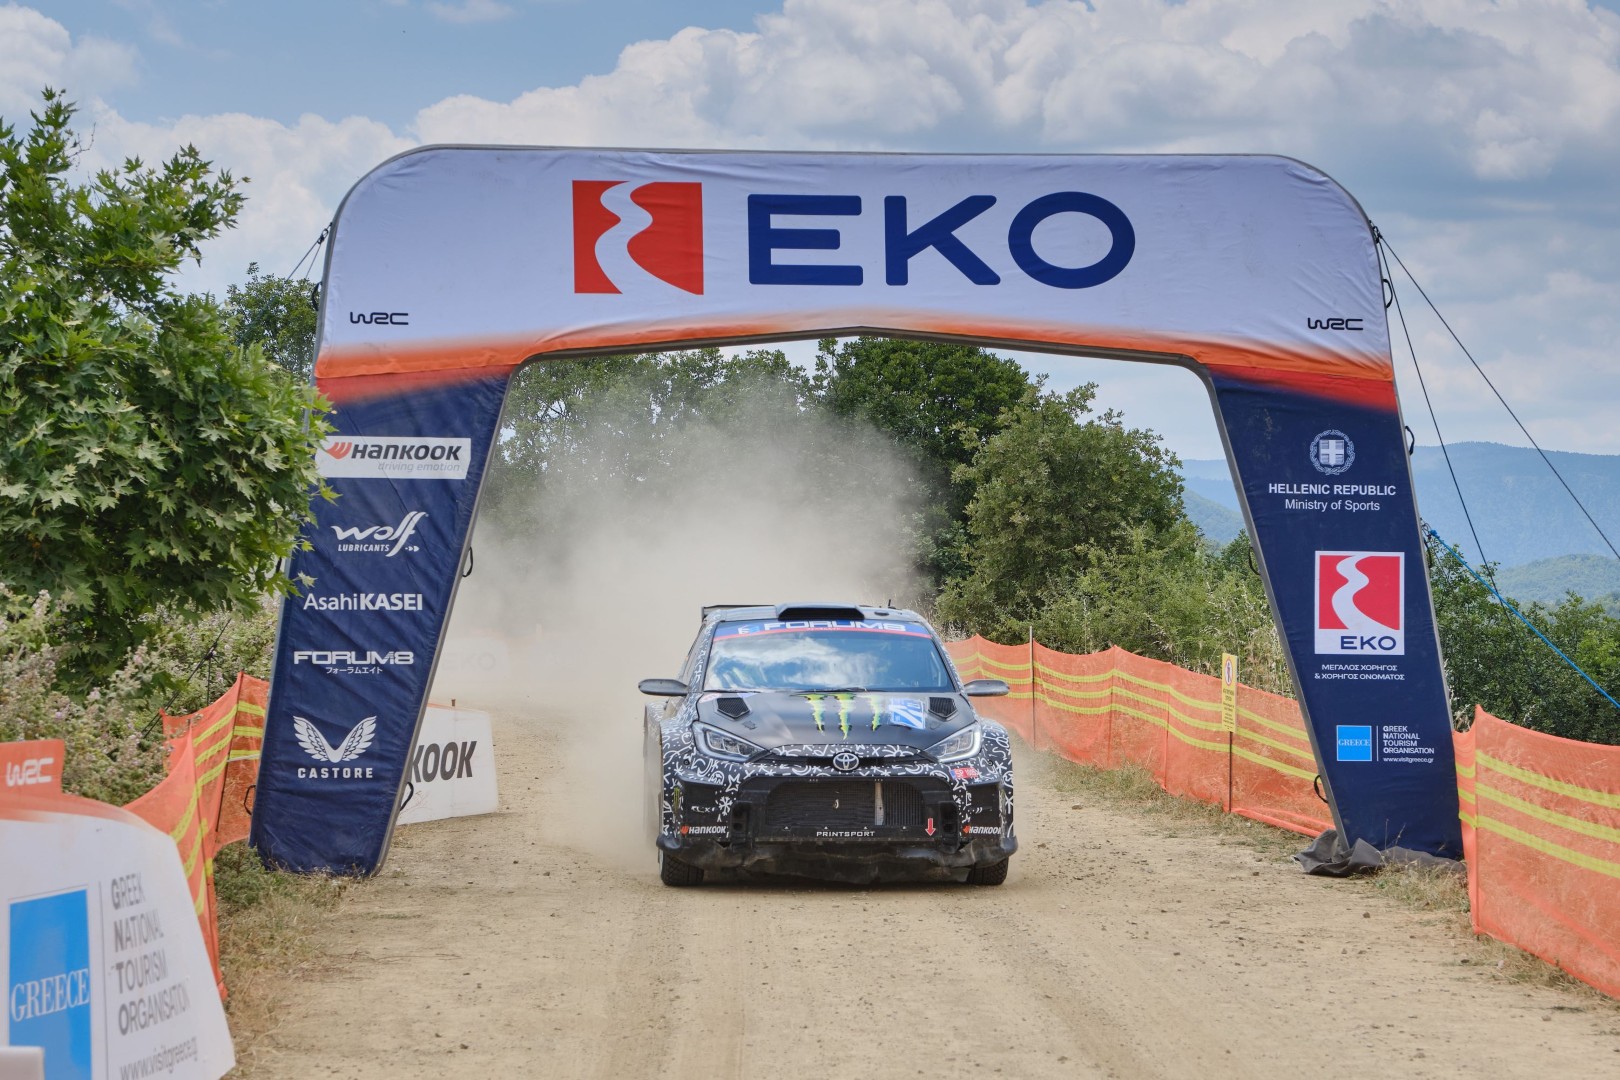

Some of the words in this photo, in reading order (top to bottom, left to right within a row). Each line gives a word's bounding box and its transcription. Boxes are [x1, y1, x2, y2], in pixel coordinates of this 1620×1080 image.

[748, 191, 1135, 289] EKO
[350, 311, 409, 325] WRC
[1307, 317, 1363, 331] WRC
[378, 461, 414, 472] driving
[417, 463, 460, 471] emotion
[1268, 483, 1330, 494] HELLENIC
[1333, 485, 1396, 495] REPUBLIC
[1285, 499, 1328, 512] Ministry
[1331, 500, 1341, 510] of
[1344, 500, 1380, 512] Sports
[338, 544, 390, 552] LUBRICANTS
[1340, 636, 1397, 650] EKO
[294, 651, 414, 665] FORUM8
[325, 666, 383, 674] フォーラムエイト
[6, 757, 54, 787] WRC
[298, 768, 373, 778] CASTORE
[110, 873, 146, 911] GREEK
[113, 909, 165, 953] NATIONAL
[115, 949, 169, 994] TOURISM
[10, 968, 90, 1022] GREECE
